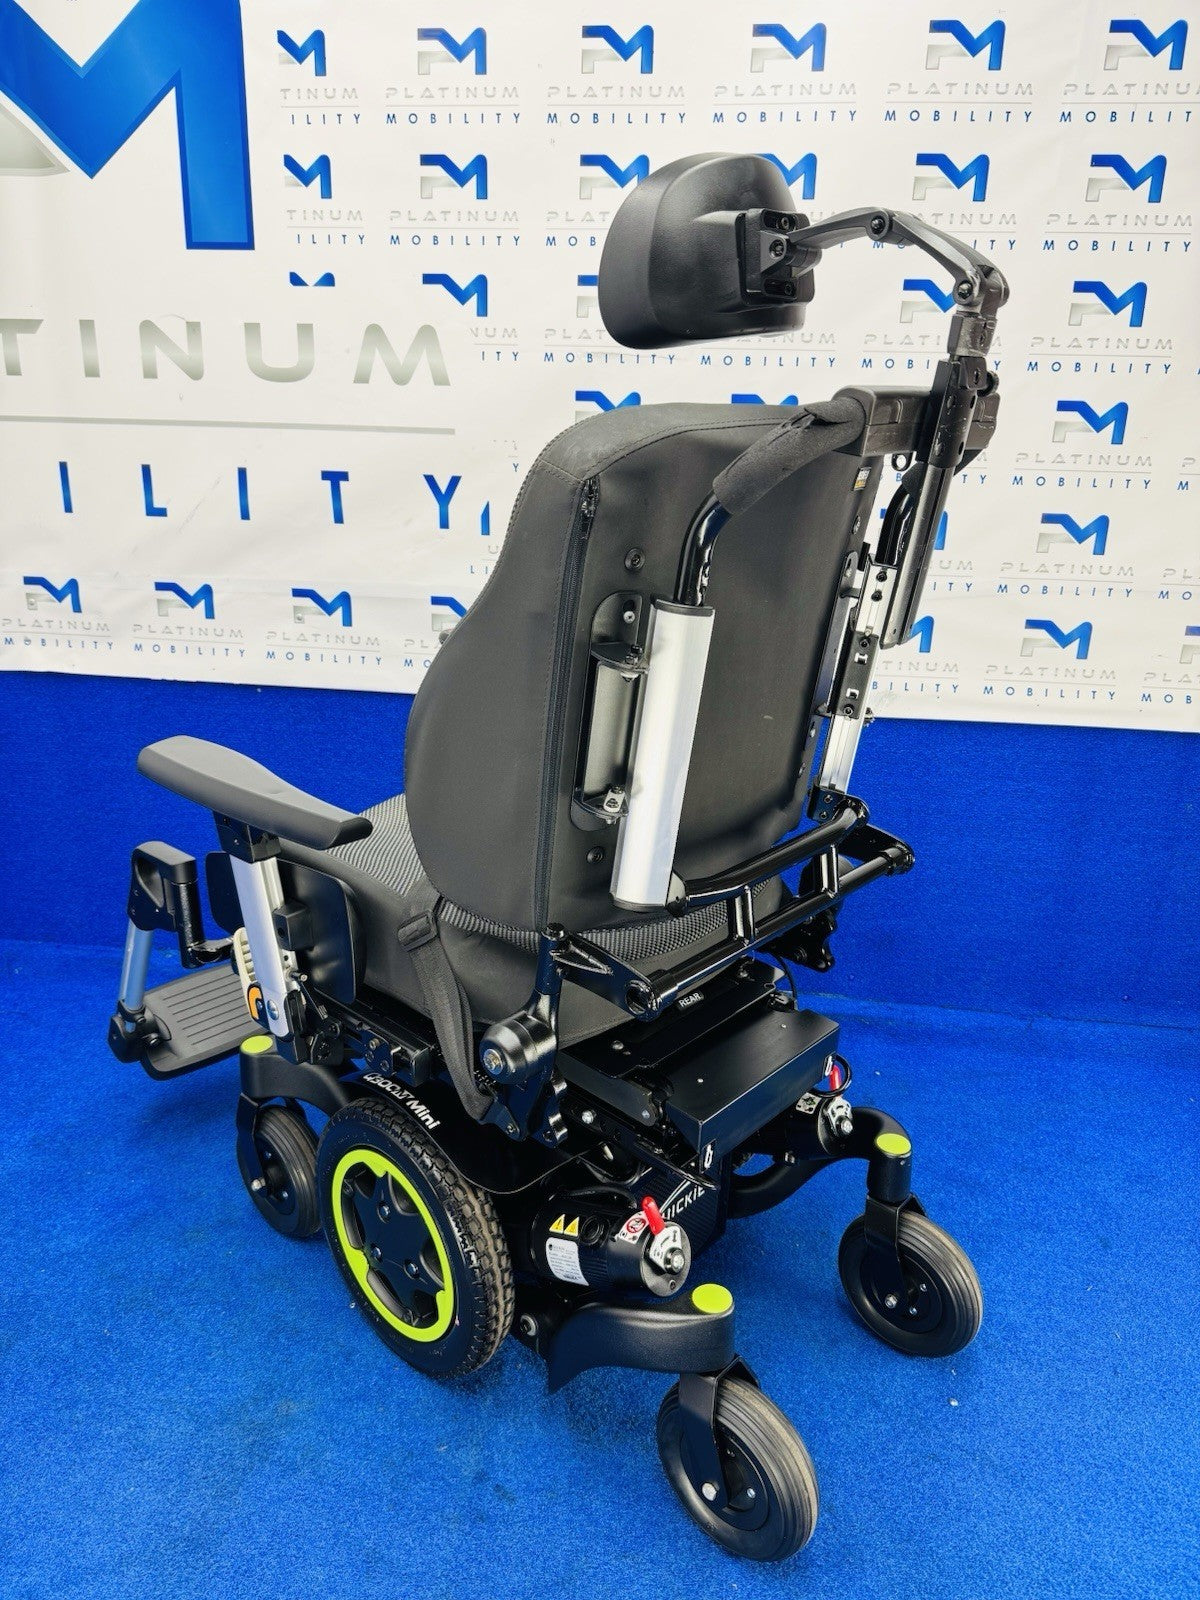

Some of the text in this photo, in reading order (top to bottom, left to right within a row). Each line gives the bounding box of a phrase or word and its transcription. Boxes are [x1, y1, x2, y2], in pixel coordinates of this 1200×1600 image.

[385, 86, 520, 99] PLATINUM
[547, 85, 686, 98] PLATINUM
[714, 83, 857, 97] PLATINUM
[887, 82, 1033, 96] PLATINUM
[1063, 83, 1200, 96] PLATINU
[291, 112, 361, 125] ILITY
[386, 112, 521, 125] MOBILITY
[547, 112, 686, 124] MOBILITY
[713, 110, 857, 123] MOBILITY
[884, 109, 1032, 123] MOBILITY
[1059, 110, 1192, 123] MOBILIT
[389, 210, 519, 222] PLATINUM
[917, 212, 1017, 225] TINUM
[1046, 213, 1193, 227] PLATINUM
[297, 234, 366, 245] ILITY
[390, 235, 520, 246] MOBILITY
[1043, 239, 1192, 252] MOBILITY
[1030, 337, 1173, 350] PLATINUM
[543, 352, 675, 364] MOBILITY
[700, 355, 836, 367] MOBILITY
[1027, 361, 1172, 375] MOBILITY
[1015, 453, 1152, 467] PLATINUM
[1012, 475, 1151, 489] MOBILITY
[59, 461, 462, 529] ILITY
[999, 562, 1134, 577] PLATINUM
[1161, 568, 1200, 580] PL
[997, 584, 1133, 598] MOBILITY
[1, 618, 111, 632] PLATINUM
[131, 624, 243, 638] PLATINUM
[266, 631, 380, 646] PLATINUM
[134, 643, 245, 658] MOBILITY
[266, 651, 382, 666] MOBILITY
[984, 664, 1116, 680] PLATINUM
[983, 686, 1116, 700] MOBILITY
[678, 992, 702, 1008] REAR
[405, 1099, 441, 1130] Mini
[661, 1185, 705, 1220] UICKIE
